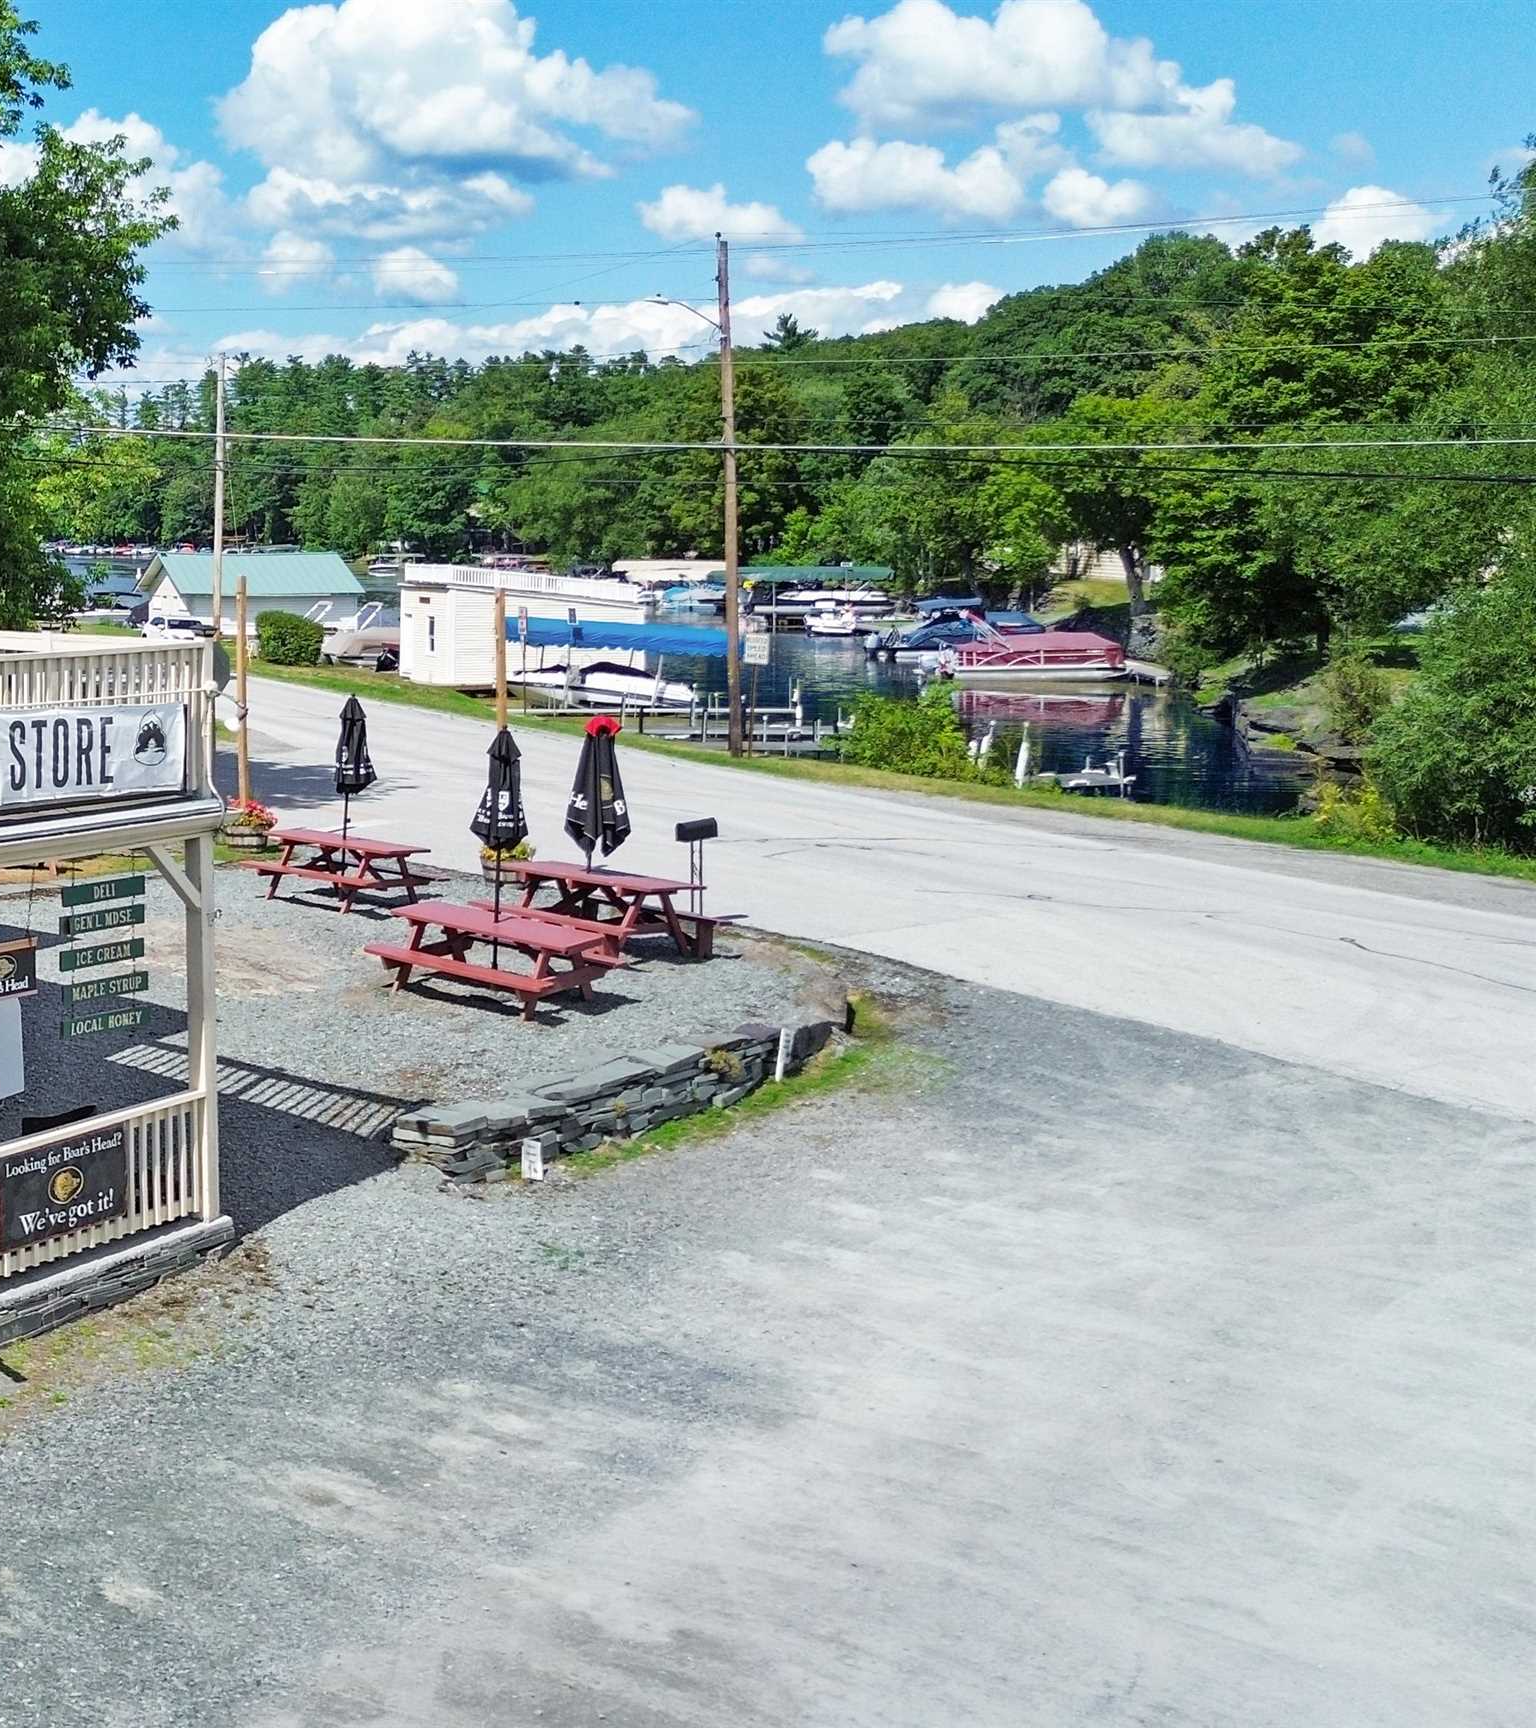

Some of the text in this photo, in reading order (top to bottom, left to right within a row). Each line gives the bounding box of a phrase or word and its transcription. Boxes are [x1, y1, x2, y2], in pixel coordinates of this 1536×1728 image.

[9, 714, 114, 791] STORE
[94, 882, 115, 899] DELI
[76, 943, 131, 966] ICE CREAM
[5, 975, 29, 992] Head
[72, 975, 142, 1002] MAPLE SYRUP
[71, 1010, 142, 1036] LOCAL HONEY
[5, 1132, 122, 1178] Looking for Boar's Head?
[19, 1187, 114, 1235] We've got it!
